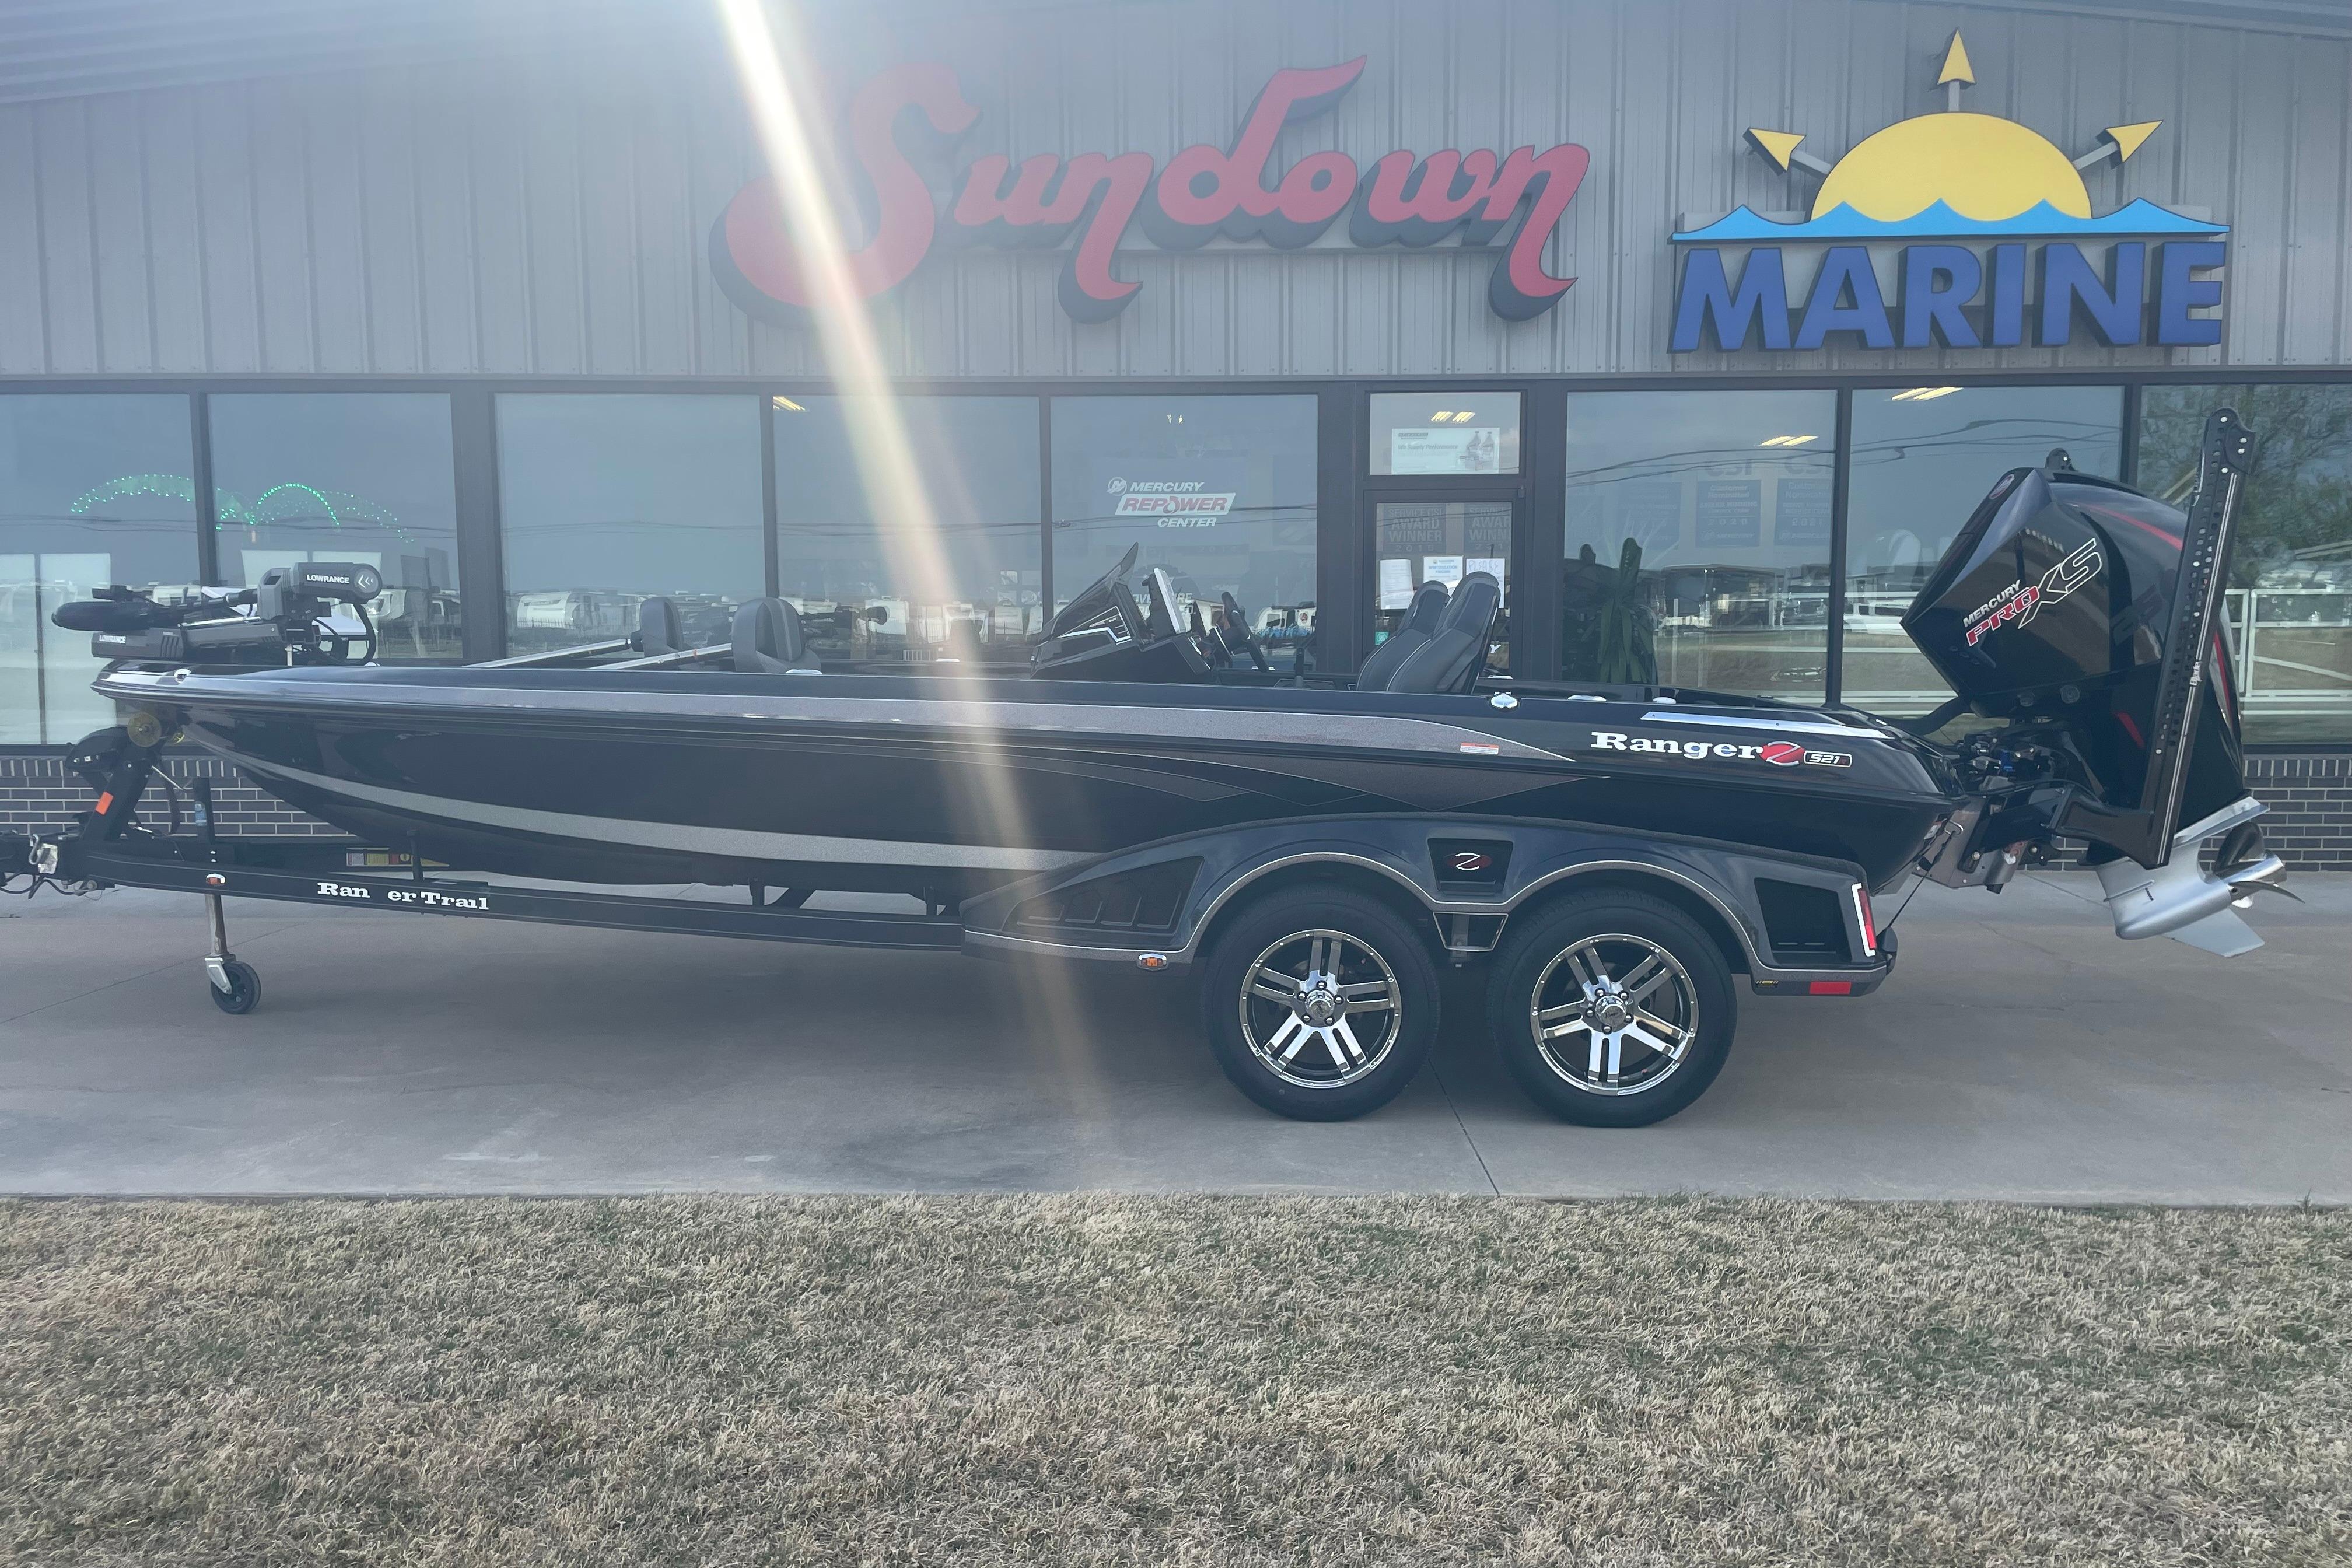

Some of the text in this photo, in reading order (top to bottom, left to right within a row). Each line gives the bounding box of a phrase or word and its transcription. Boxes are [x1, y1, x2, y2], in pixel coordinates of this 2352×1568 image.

[723, 55, 1590, 310] Sundown
[1670, 241, 2226, 352] MARINE
[1130, 482, 1205, 492] MERCURY
[1122, 496, 1228, 514] REPOWER
[1390, 508, 1425, 517] SERVICE
[1157, 517, 1217, 527] CENTER
[1391, 518, 1440, 530] AWARD
[1390, 530, 1443, 542] WINNER
[306, 574, 349, 584] LOWRANCE
[1966, 537, 2102, 646] PRO XS
[1962, 579, 2021, 628] MERCURY
[1590, 731, 1763, 759] Ranger
[421, 891, 489, 910] Trail
